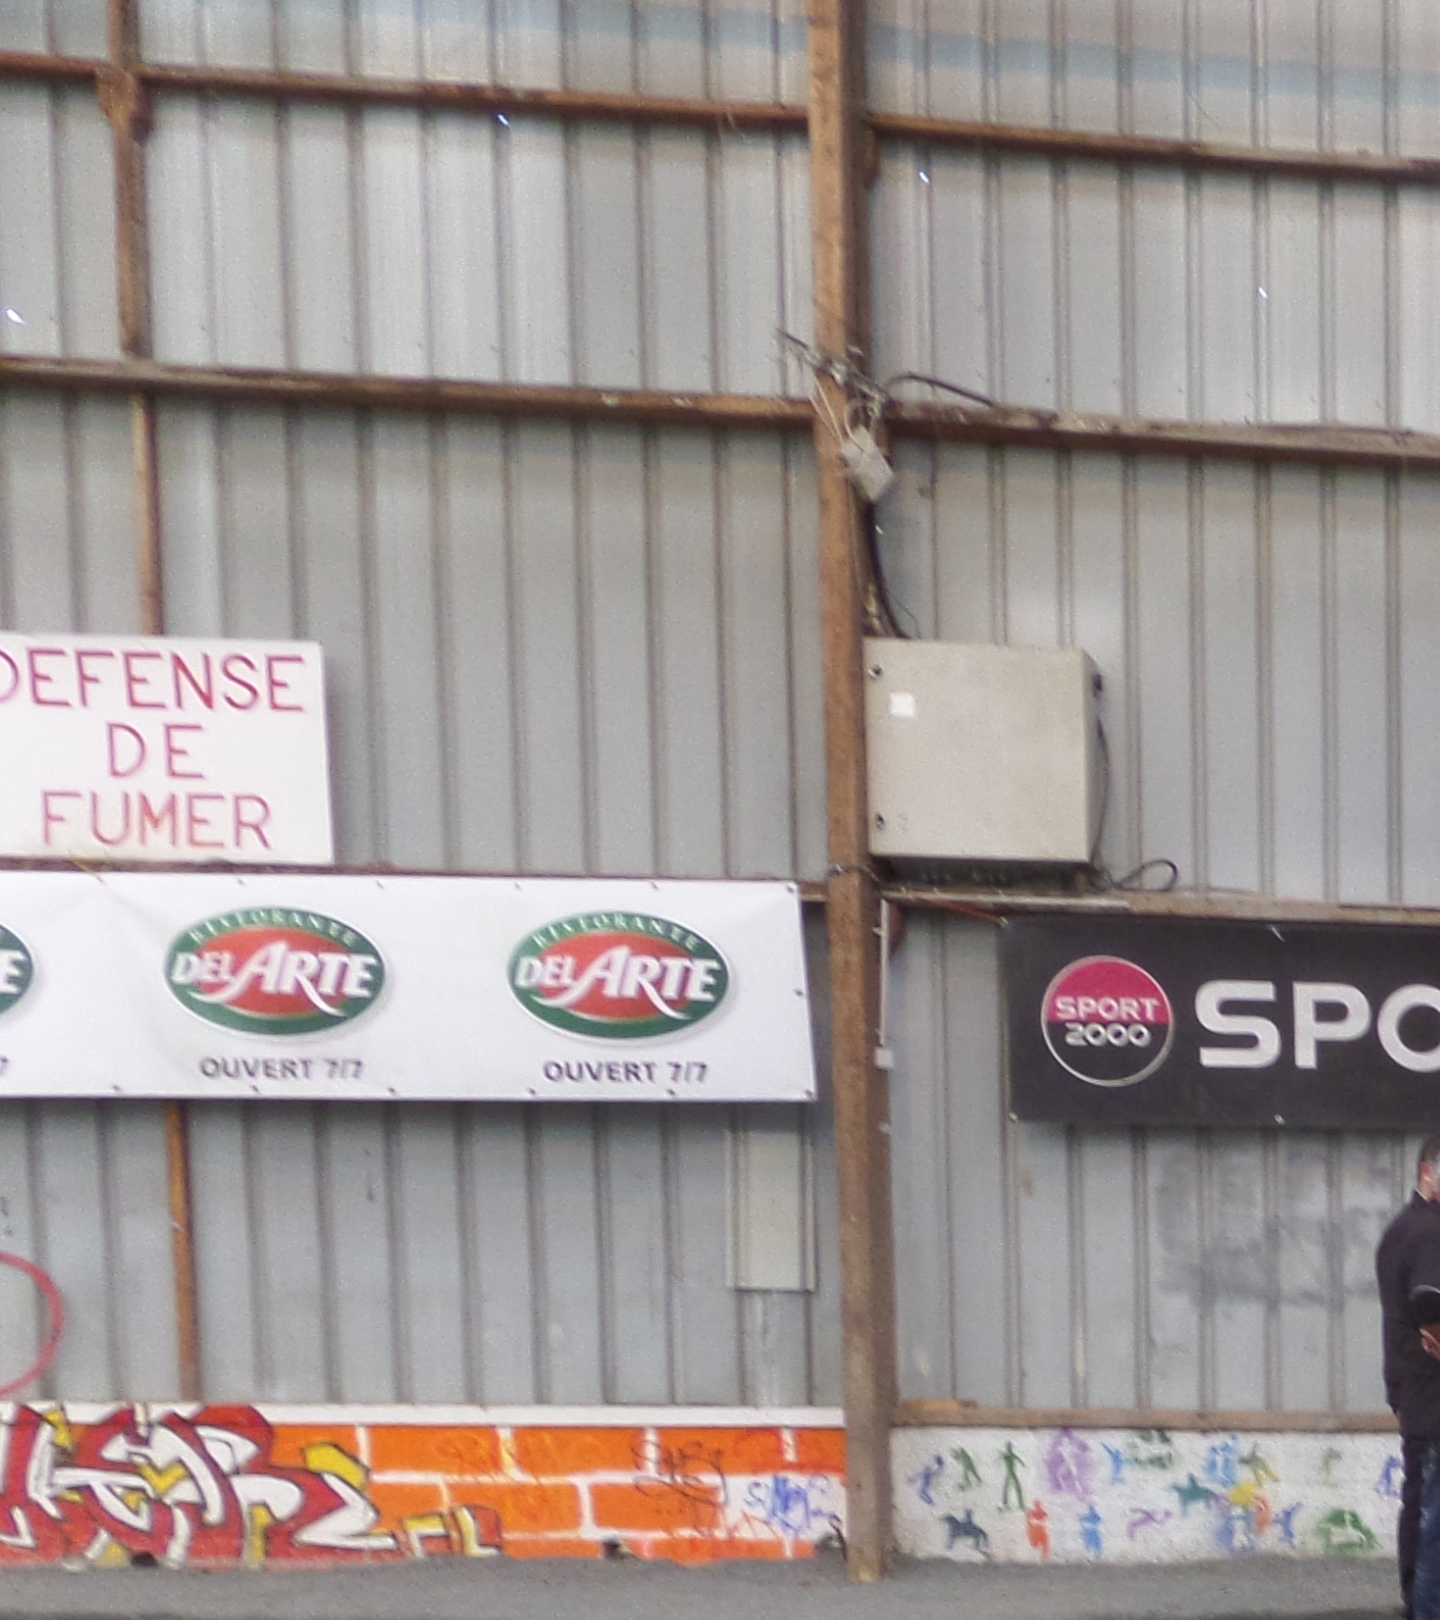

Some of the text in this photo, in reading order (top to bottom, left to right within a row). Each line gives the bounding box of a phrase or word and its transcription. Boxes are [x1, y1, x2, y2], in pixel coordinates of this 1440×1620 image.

[107, 722, 205, 778] DE
[42, 791, 272, 849] FUMER
[1055, 996, 1161, 1021] SPORT
[1065, 1022, 1152, 1048] 2000
[201, 1056, 364, 1080] OUVERT 7/7
[543, 1061, 708, 1085] OUVERT 7/7
